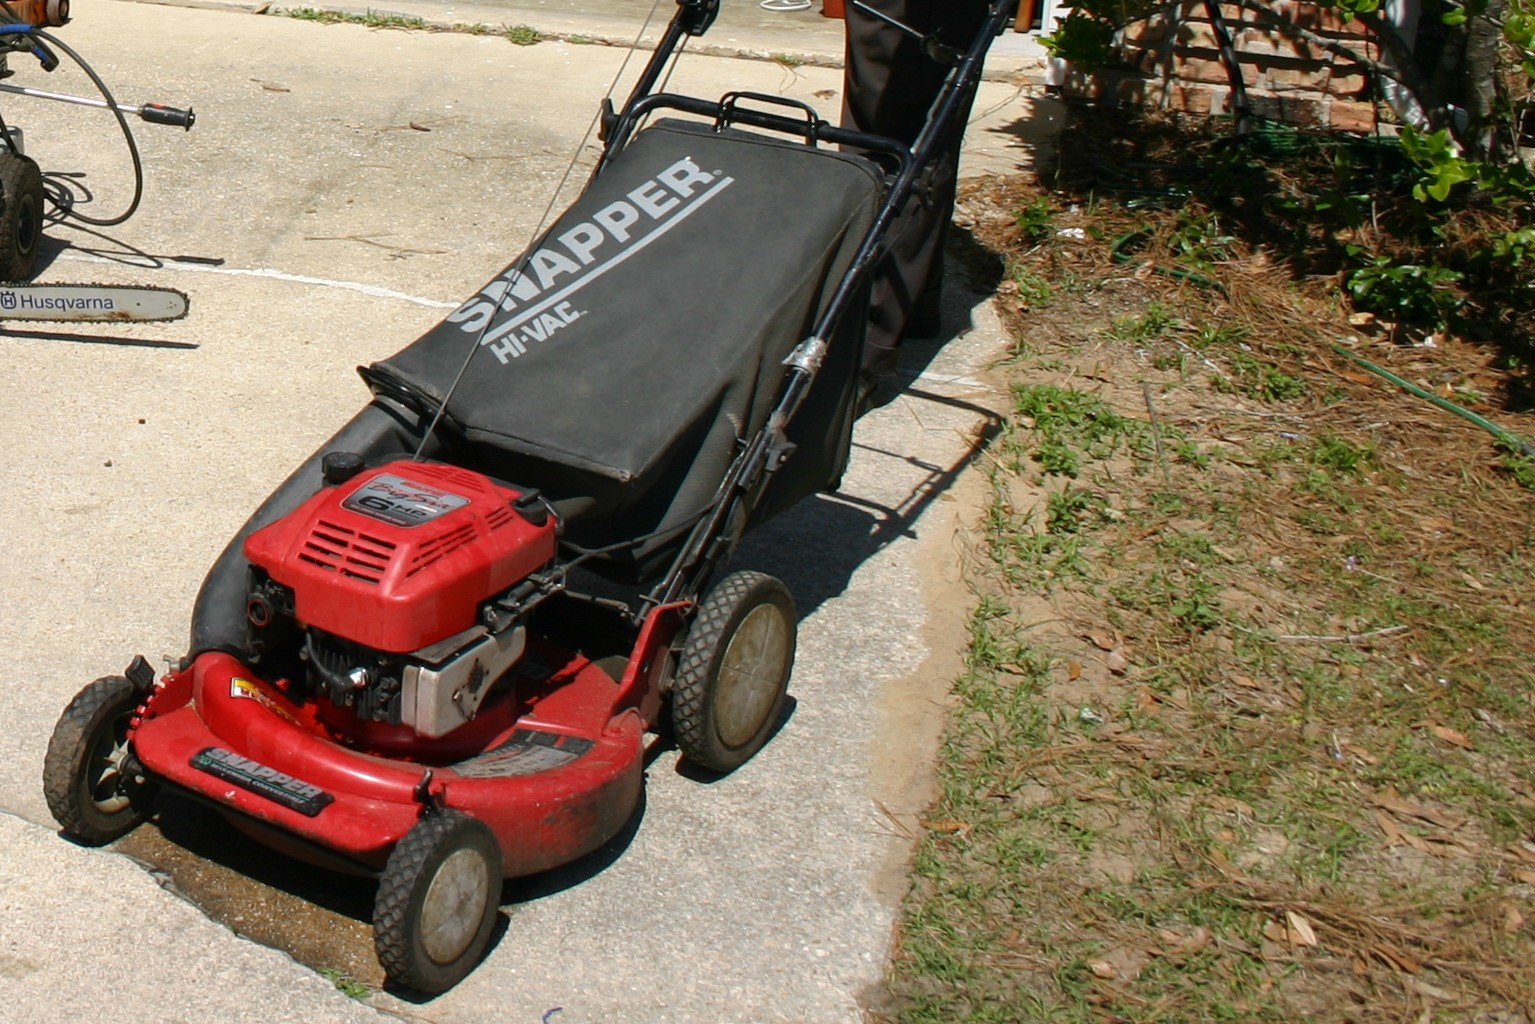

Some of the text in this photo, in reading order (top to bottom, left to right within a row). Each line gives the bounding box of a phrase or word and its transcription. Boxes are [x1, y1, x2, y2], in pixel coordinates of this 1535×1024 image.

[446, 158, 716, 334] SNAPPER
[20, 294, 114, 312] Husqvarna
[357, 495, 395, 512] 6
[206, 748, 323, 798] SNAPPER
